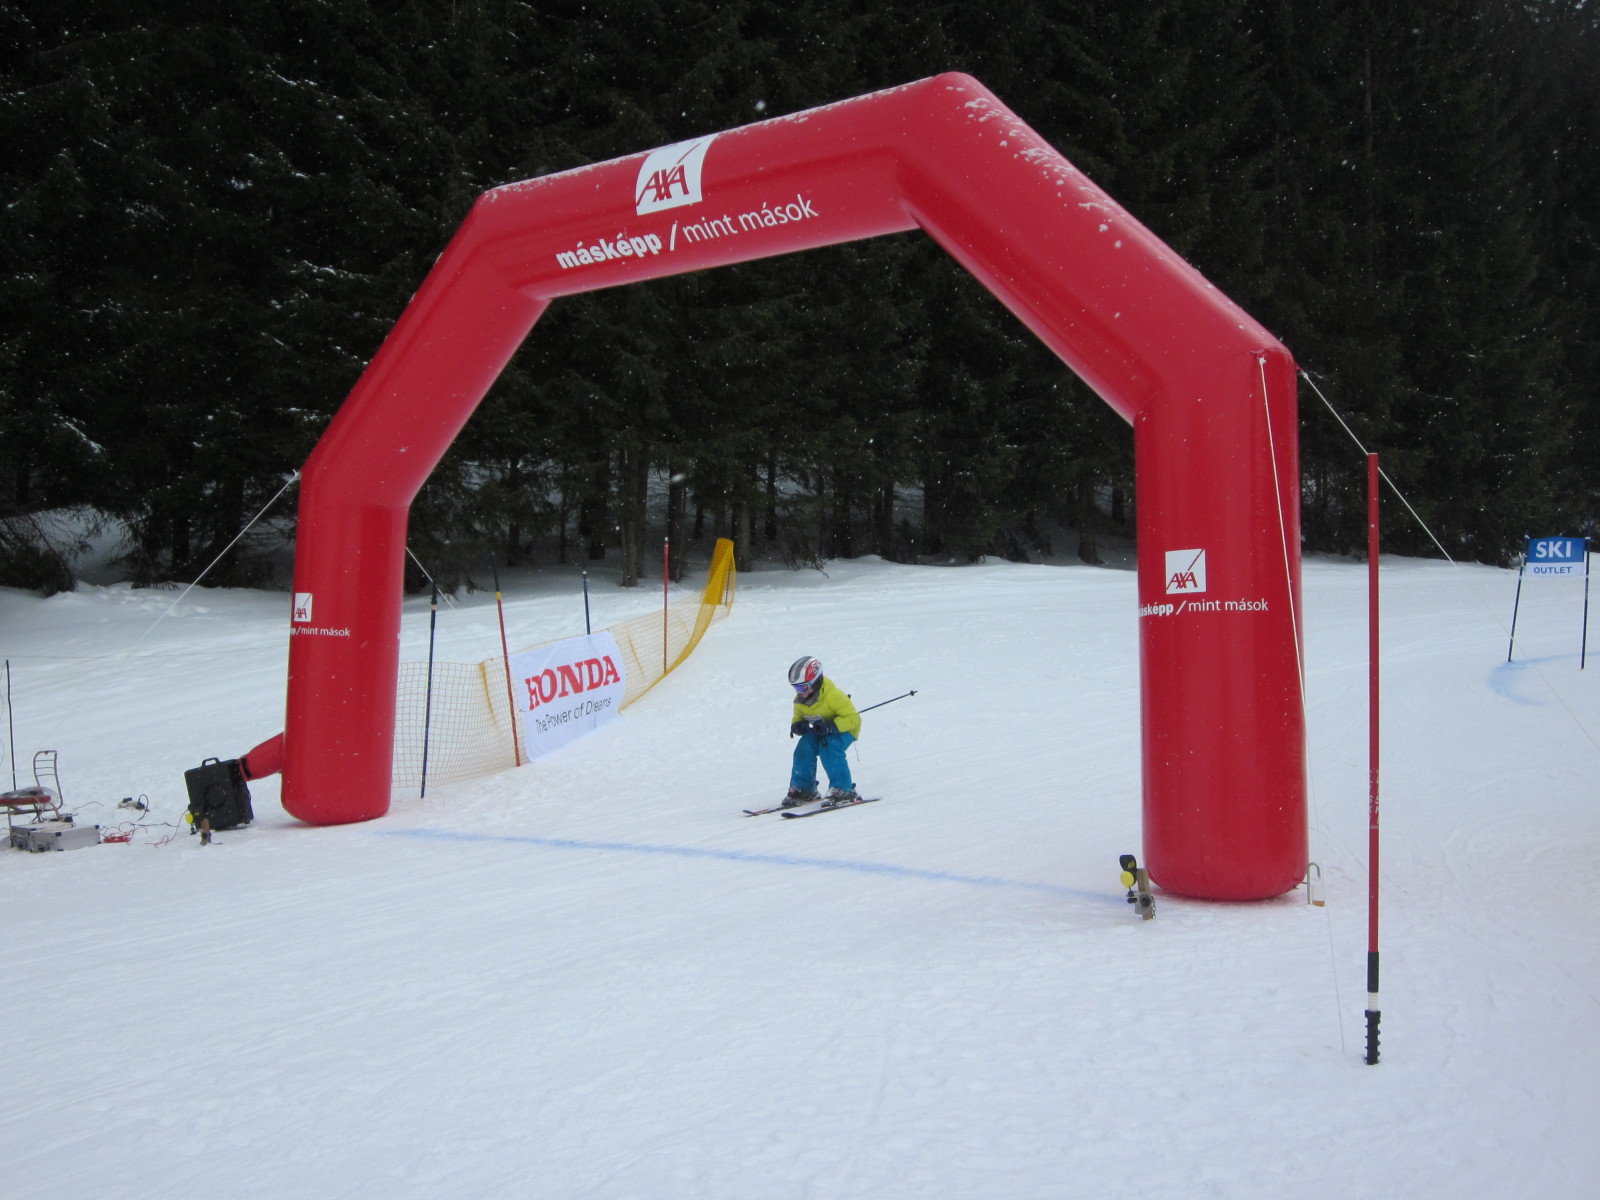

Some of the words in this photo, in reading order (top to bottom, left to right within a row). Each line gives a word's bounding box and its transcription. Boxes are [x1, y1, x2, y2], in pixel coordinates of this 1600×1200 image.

[636, 165, 689, 207] AXA
[556, 233, 662, 269] másképp
[738, 194, 819, 232] mások
[1535, 541, 1571, 557] SKI
[1166, 572, 1198, 590] AXA
[1138, 601, 1174, 617] ásképp
[1224, 597, 1269, 611] mások
[320, 627, 350, 637] mások
[525, 655, 620, 711] HONDA
[545, 709, 572, 730] Power
[573, 702, 584, 719] of
[585, 697, 612, 715] Deams
